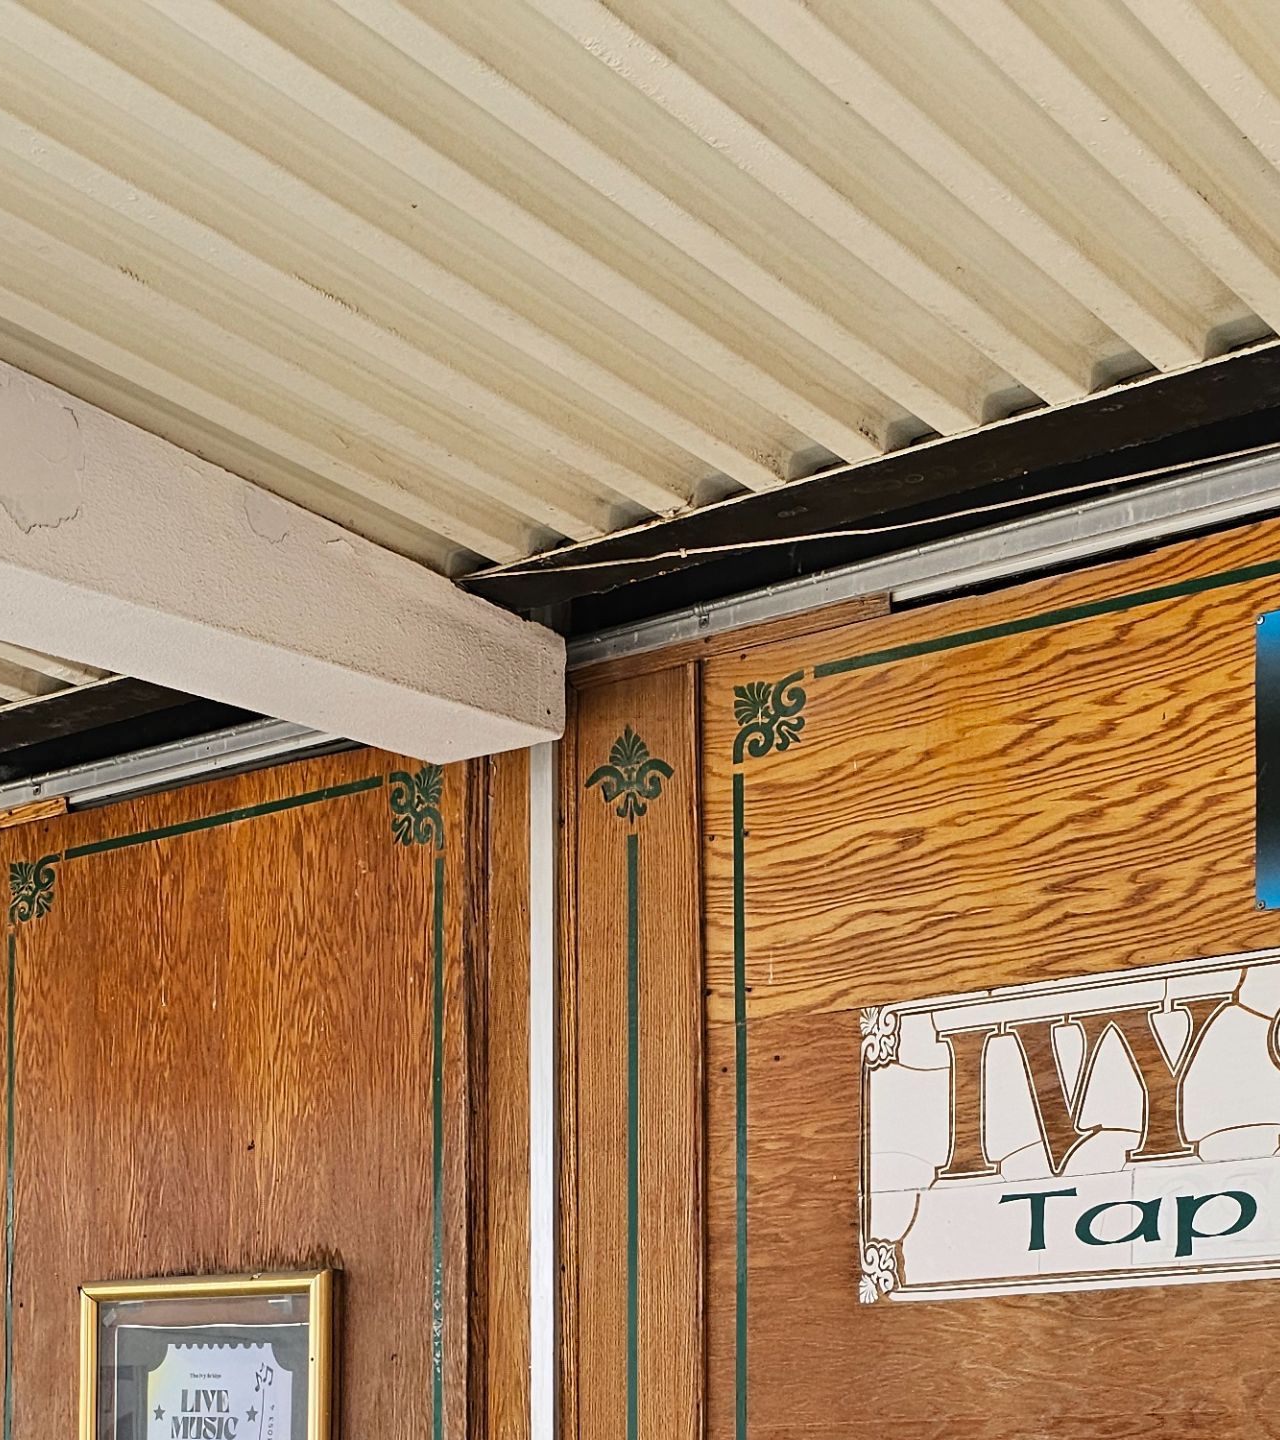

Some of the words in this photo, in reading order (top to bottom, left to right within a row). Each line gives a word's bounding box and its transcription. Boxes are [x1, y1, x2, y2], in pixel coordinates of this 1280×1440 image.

[934, 990, 1242, 1182] IVY
[998, 1186, 1258, 1258] Tap
[180, 1389, 230, 1413] LIVE
[171, 1416, 239, 1440] MUSIC
